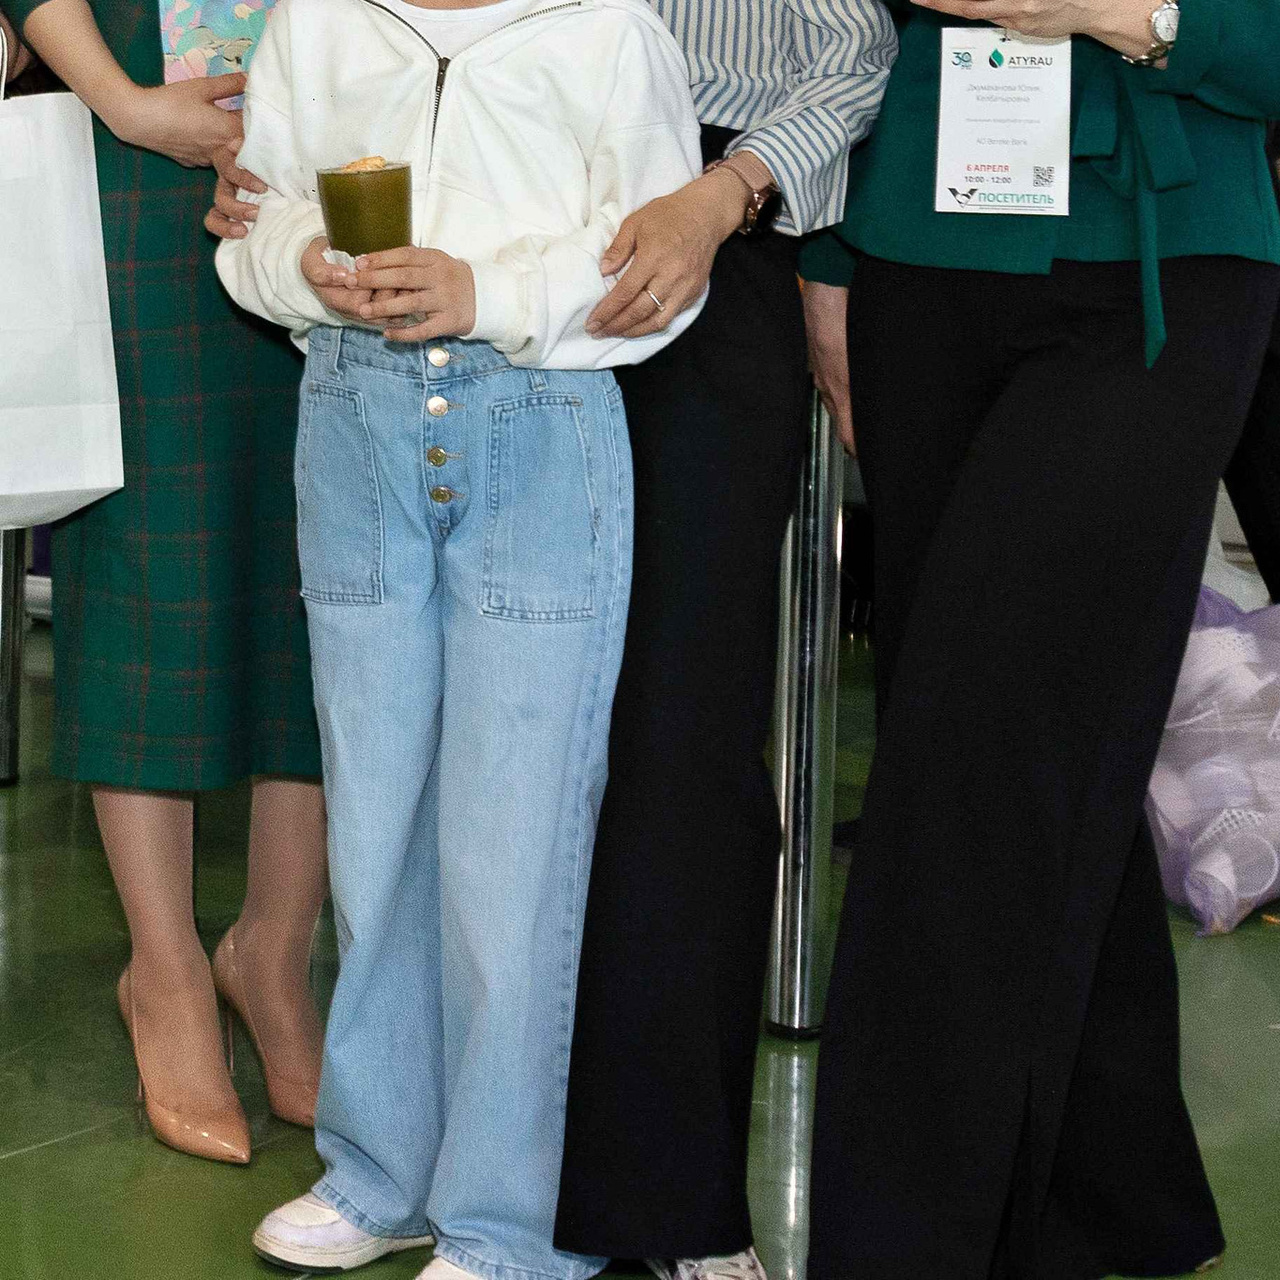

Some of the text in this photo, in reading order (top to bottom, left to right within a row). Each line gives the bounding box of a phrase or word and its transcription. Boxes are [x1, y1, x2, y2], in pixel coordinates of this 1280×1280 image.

[1008, 56, 1053, 66] ATYRAU
[966, 164, 1010, 172] 6 АПРЕЛЯ
[964, 175, 985, 183] 10:00
[991, 176, 1012, 184] 12:00
[978, 192, 1055, 204] ПОСЕТИТЕЛЬ
